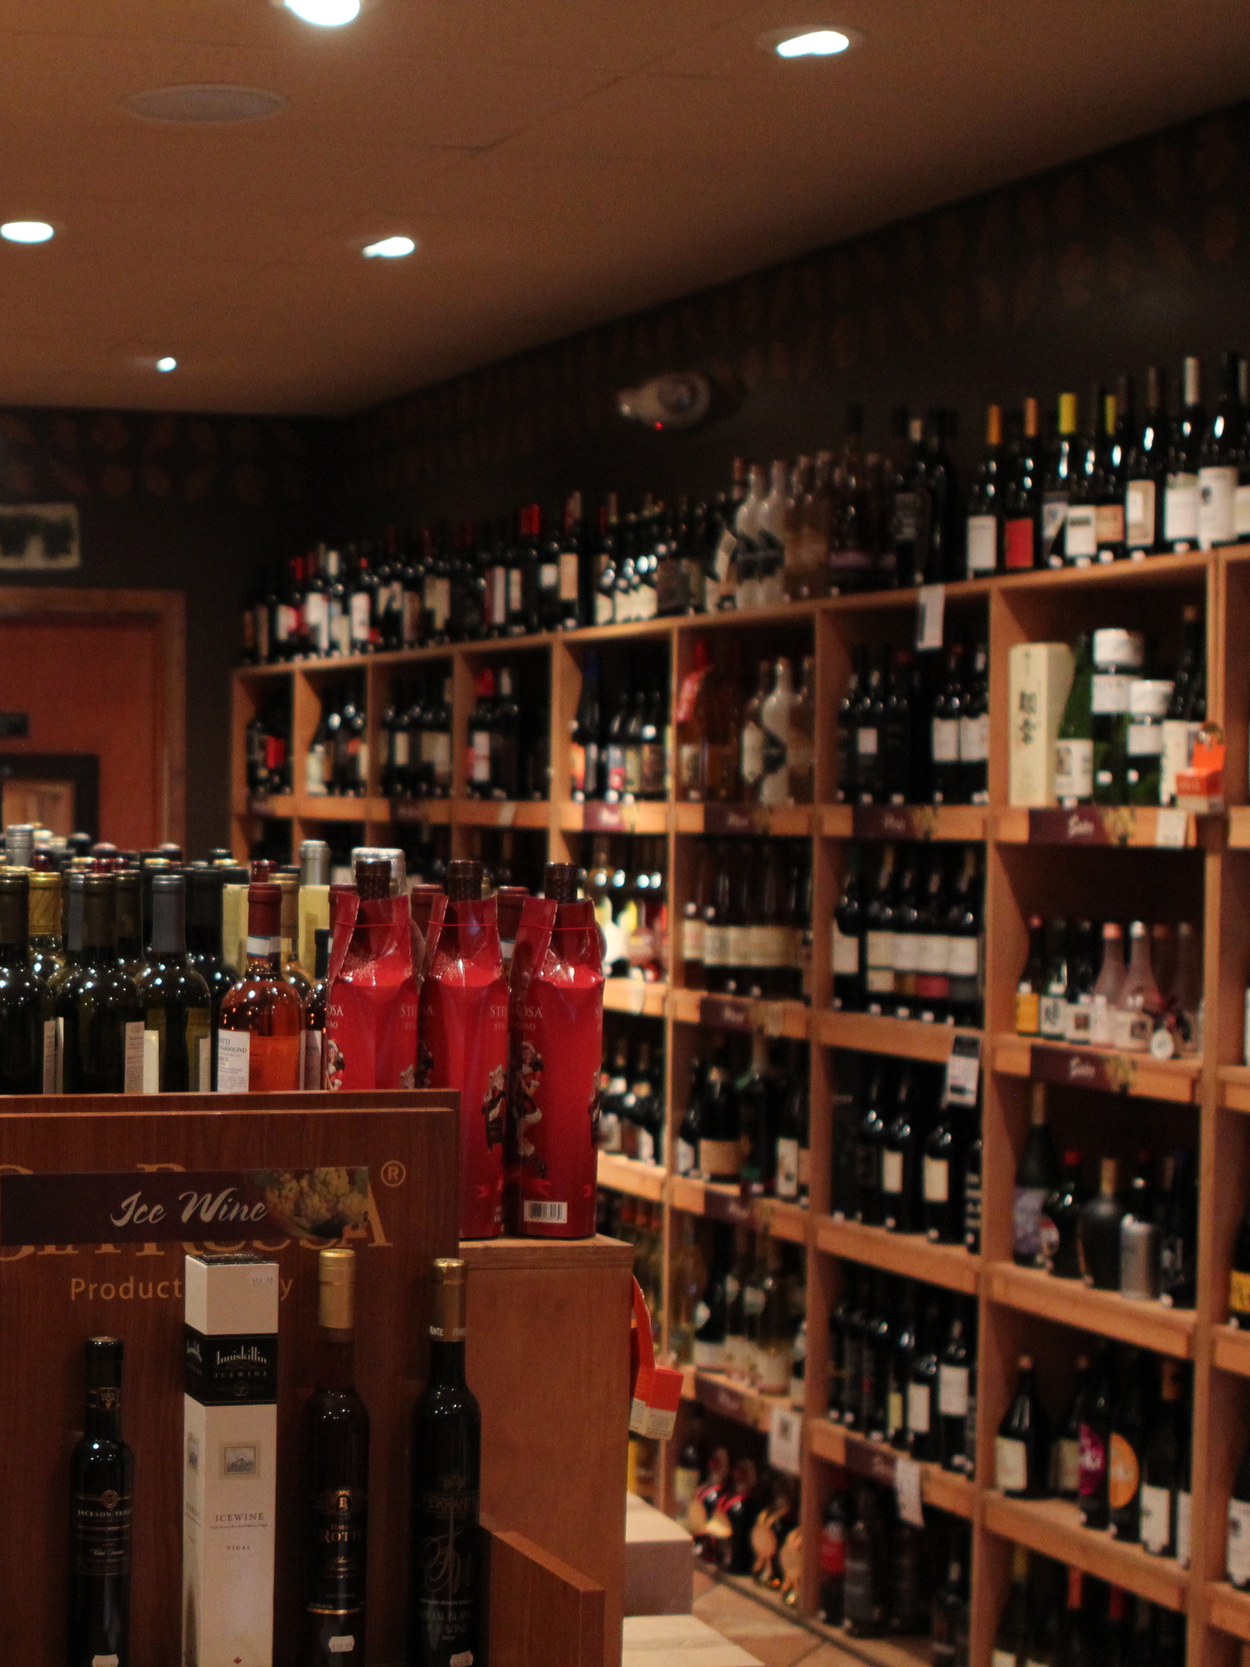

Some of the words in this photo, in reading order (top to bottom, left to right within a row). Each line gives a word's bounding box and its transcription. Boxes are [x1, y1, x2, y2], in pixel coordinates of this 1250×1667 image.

[110, 1191, 167, 1227] Ice
[178, 1187, 269, 1223] Wine
[71, 1276, 182, 1301] Product
[216, 1345, 268, 1366] Inniskillin
[214, 1371, 269, 1379] ICEWINE
[77, 1509, 112, 1517] JACKSON
[214, 1512, 265, 1522] ICEWINE
